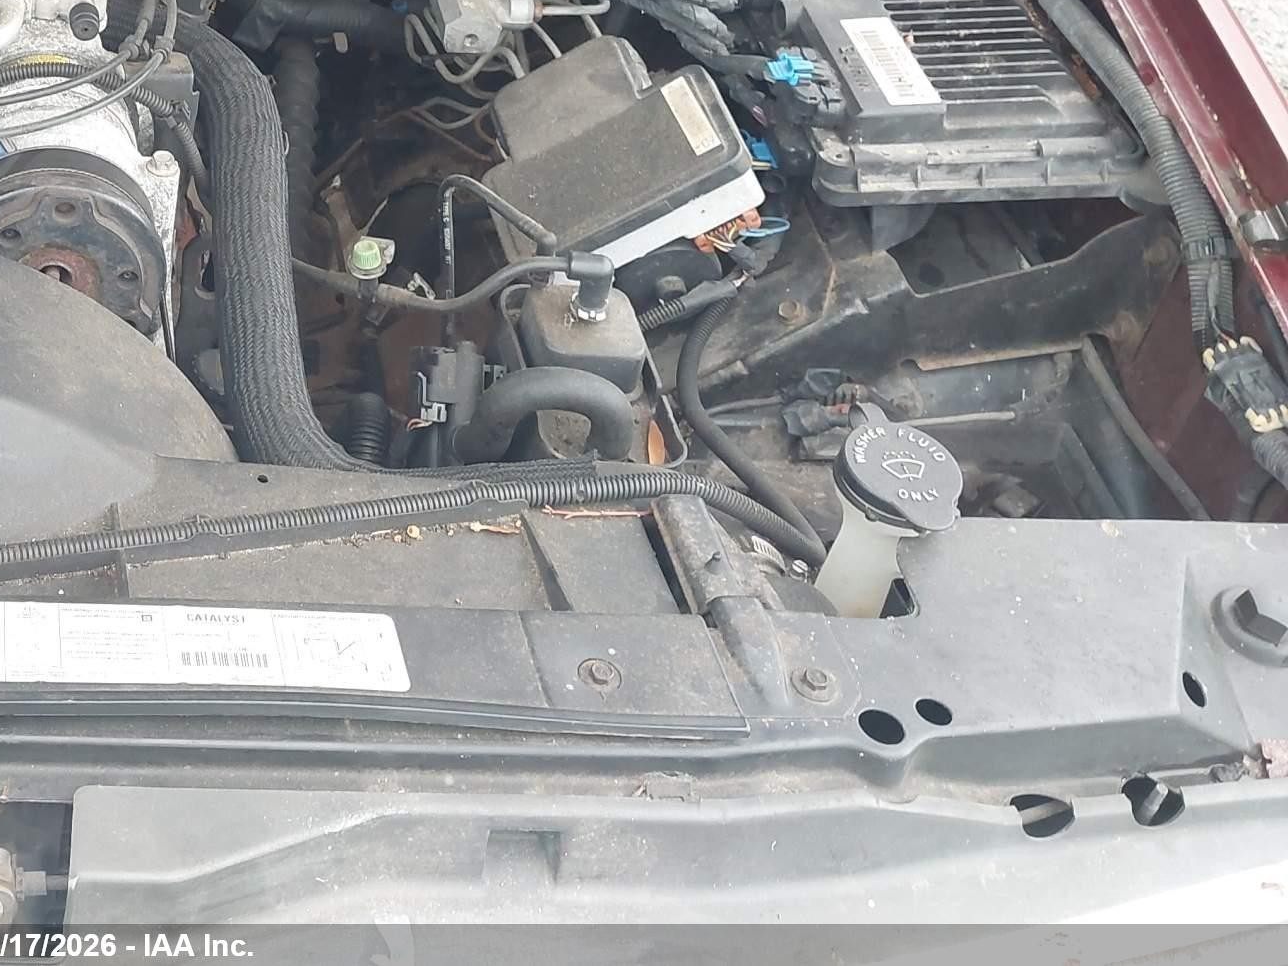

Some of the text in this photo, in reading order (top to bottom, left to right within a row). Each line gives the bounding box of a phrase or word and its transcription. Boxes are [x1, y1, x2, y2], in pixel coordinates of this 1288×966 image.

[852, 426, 947, 464] WASHER FLUID
[898, 487, 941, 502] ONLY
